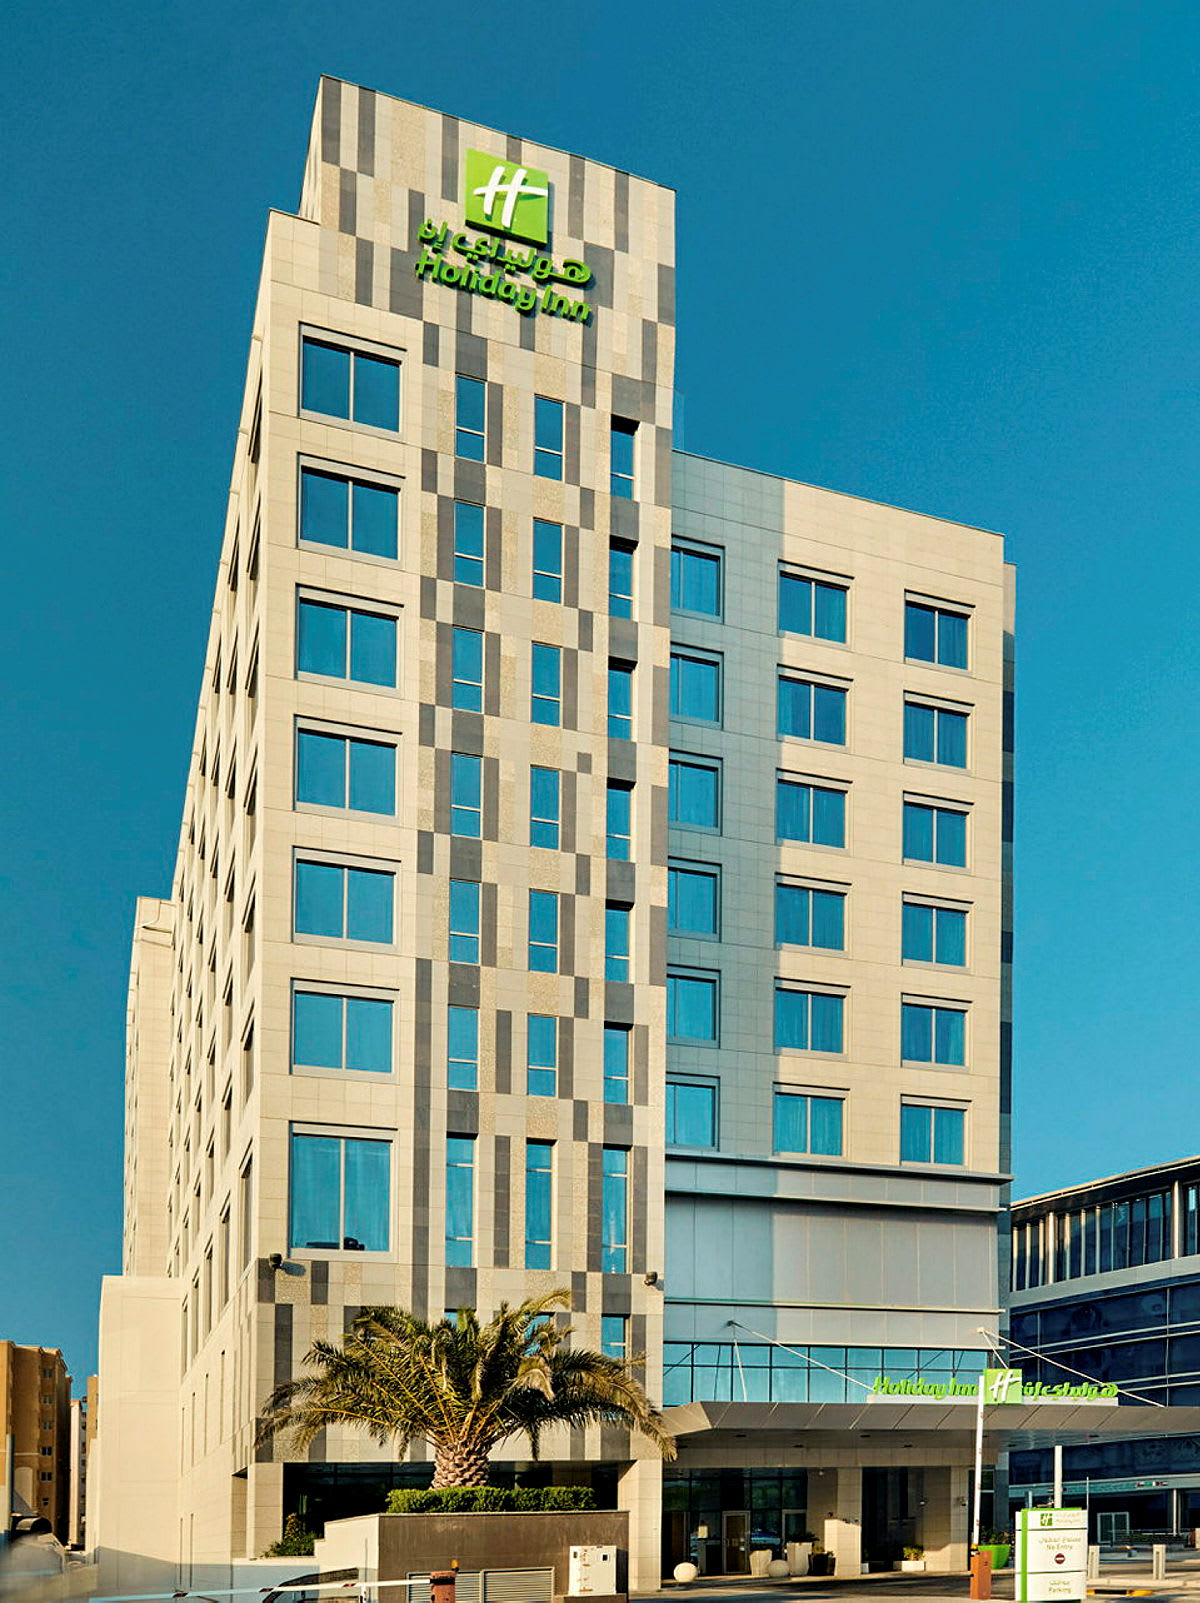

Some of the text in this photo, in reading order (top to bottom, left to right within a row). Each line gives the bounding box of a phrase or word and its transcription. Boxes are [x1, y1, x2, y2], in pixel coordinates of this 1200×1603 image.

[415, 249, 591, 323] Holiday Inn
[452, 230, 592, 286] هوليداي
[873, 1376, 979, 1400] Holiday Inn
